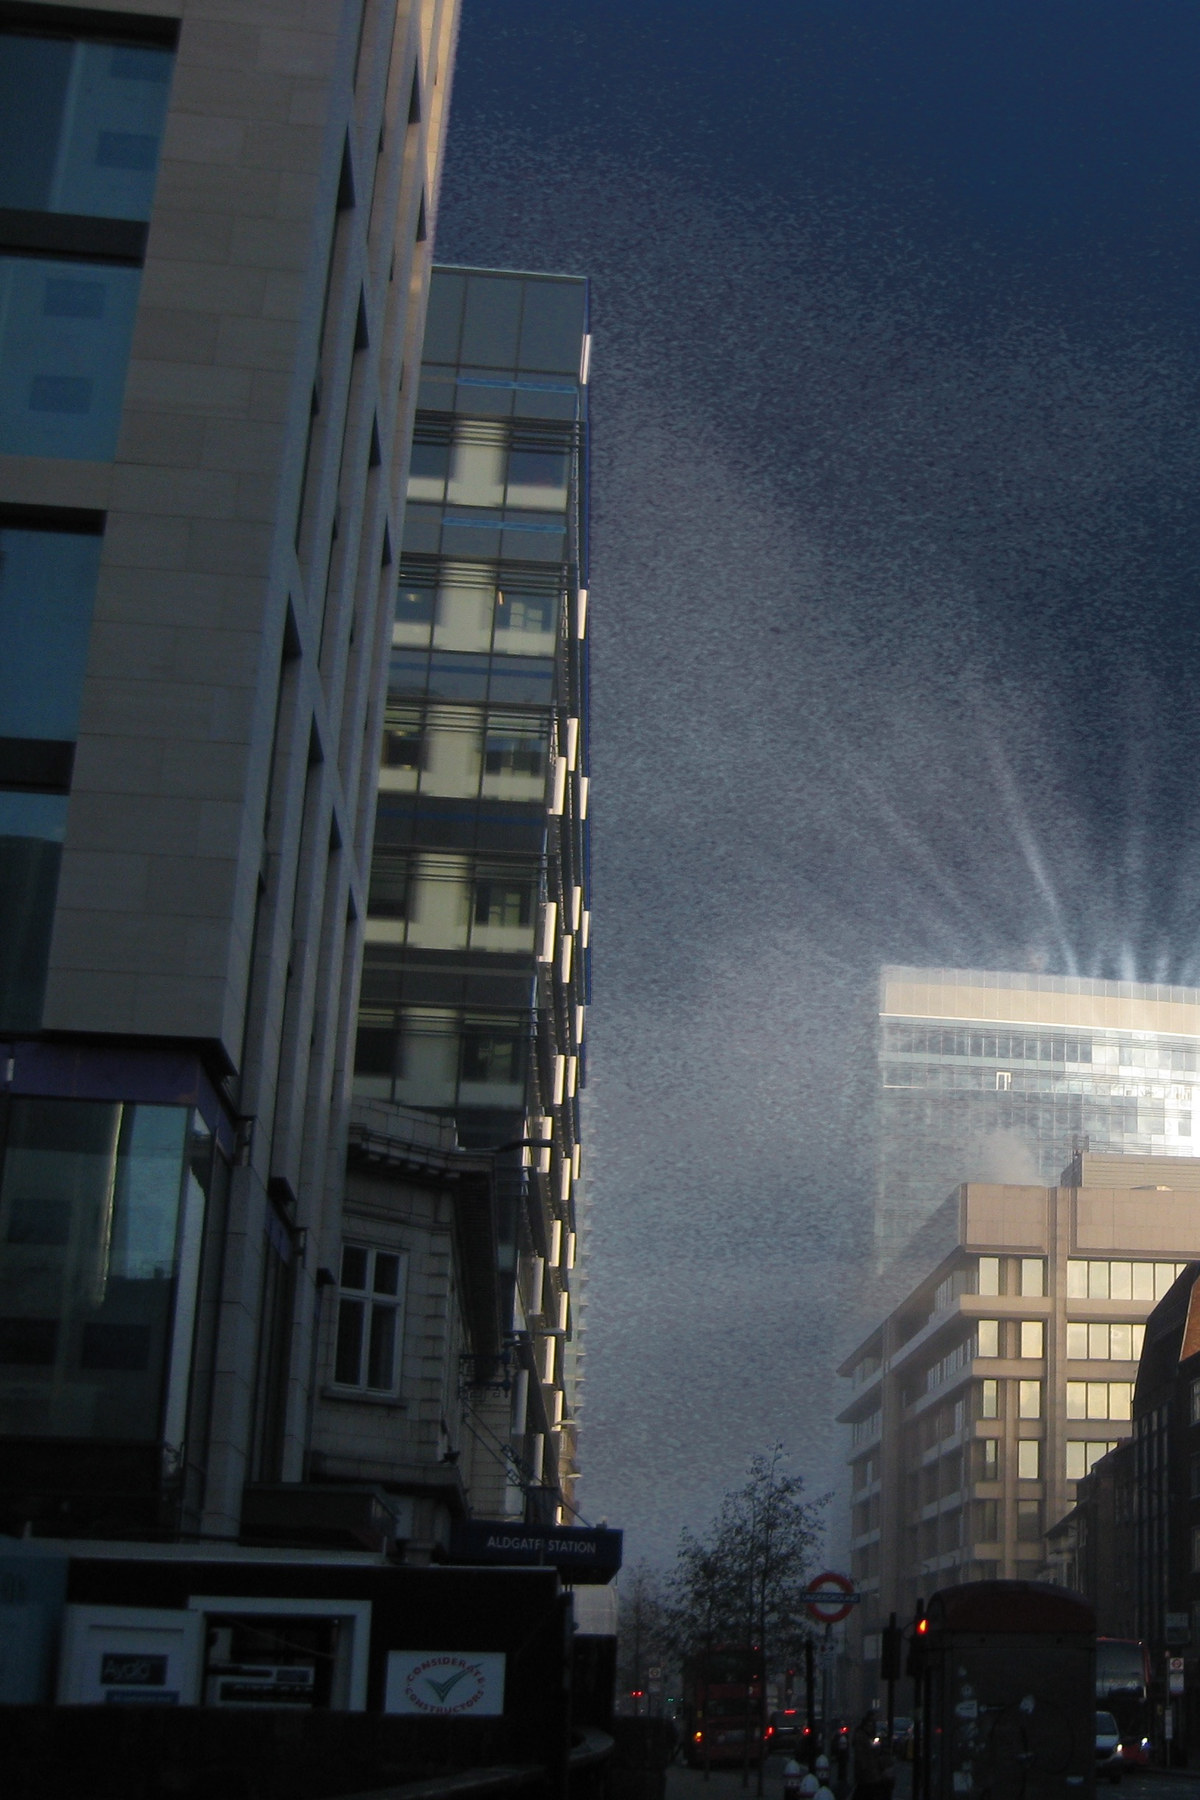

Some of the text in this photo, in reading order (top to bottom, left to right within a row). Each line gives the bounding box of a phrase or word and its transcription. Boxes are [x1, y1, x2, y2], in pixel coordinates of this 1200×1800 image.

[486, 1536, 597, 1554] ALDGATE STATION
[407, 1656, 487, 1684] CONSIDERATE
[405, 1686, 485, 1713] CONSTRUCTORS
